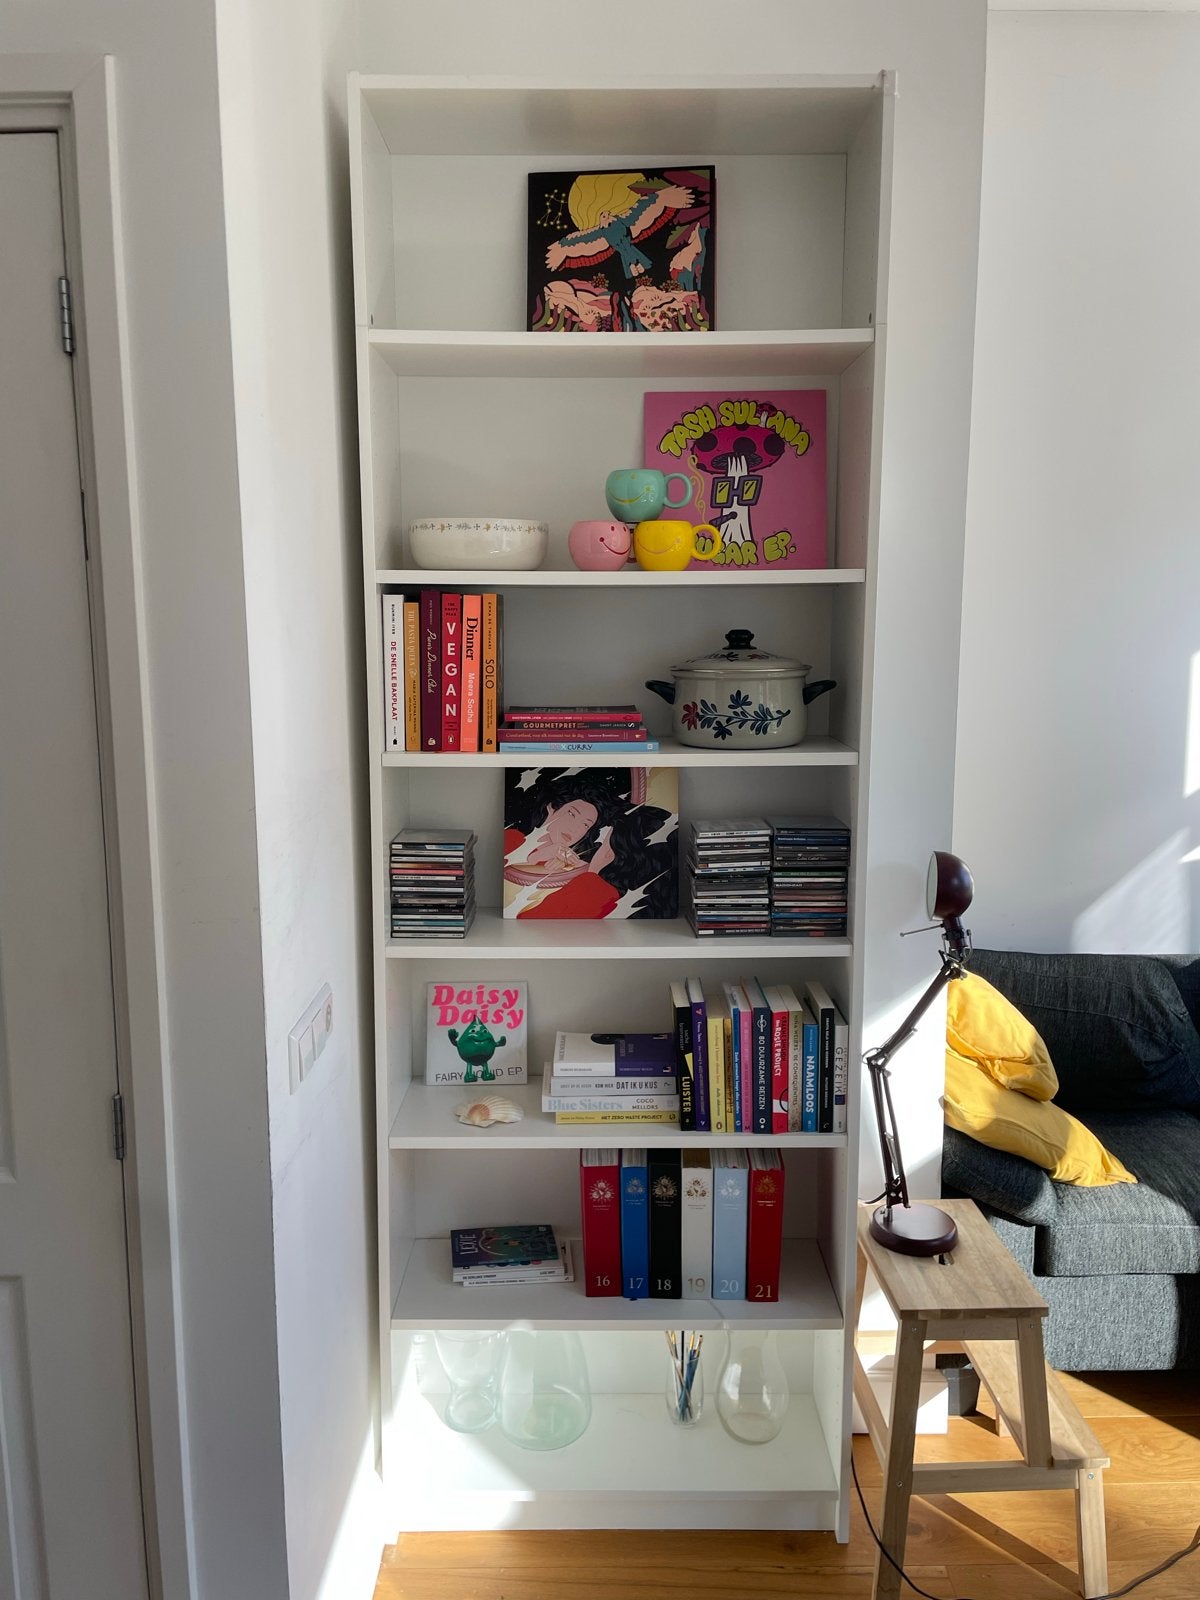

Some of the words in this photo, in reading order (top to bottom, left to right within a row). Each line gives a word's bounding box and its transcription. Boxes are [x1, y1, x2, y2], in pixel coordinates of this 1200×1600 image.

[659, 405, 717, 457] TASH
[763, 530, 796, 562] EP.
[390, 641, 397, 652] DE
[466, 617, 478, 661] Dinner
[445, 622, 458, 717] VEGAN
[485, 659, 495, 689] SOLO
[467, 672, 476, 698] Meera
[467, 698, 475, 723] Sodha
[432, 984, 519, 1009] Daisy
[436, 1004, 524, 1030] Daisy
[758, 1036, 765, 1044] 80
[774, 1027, 782, 1048] ROSIE
[435, 1071, 464, 1083] FAIRY
[508, 1066, 522, 1076] EP
[774, 1048, 782, 1076] PROJECT
[835, 1047, 843, 1093] GEZEIK
[616, 1082, 629, 1090] DAT
[630, 1082, 638, 1090] IK
[639, 1082, 644, 1090] U
[644, 1082, 658, 1090] KUS
[682, 1076, 692, 1112] LUISTER
[806, 1056, 815, 1113] NAAMLOOS
[548, 1099, 577, 1111] Blue
[579, 1098, 624, 1110] Sisters
[596, 1276, 610, 1287] 16
[629, 1277, 644, 1289] 17
[657, 1279, 672, 1290] 18
[688, 1278, 706, 1294] 19
[720, 1280, 739, 1293] 20
[755, 1285, 772, 1298] 21
